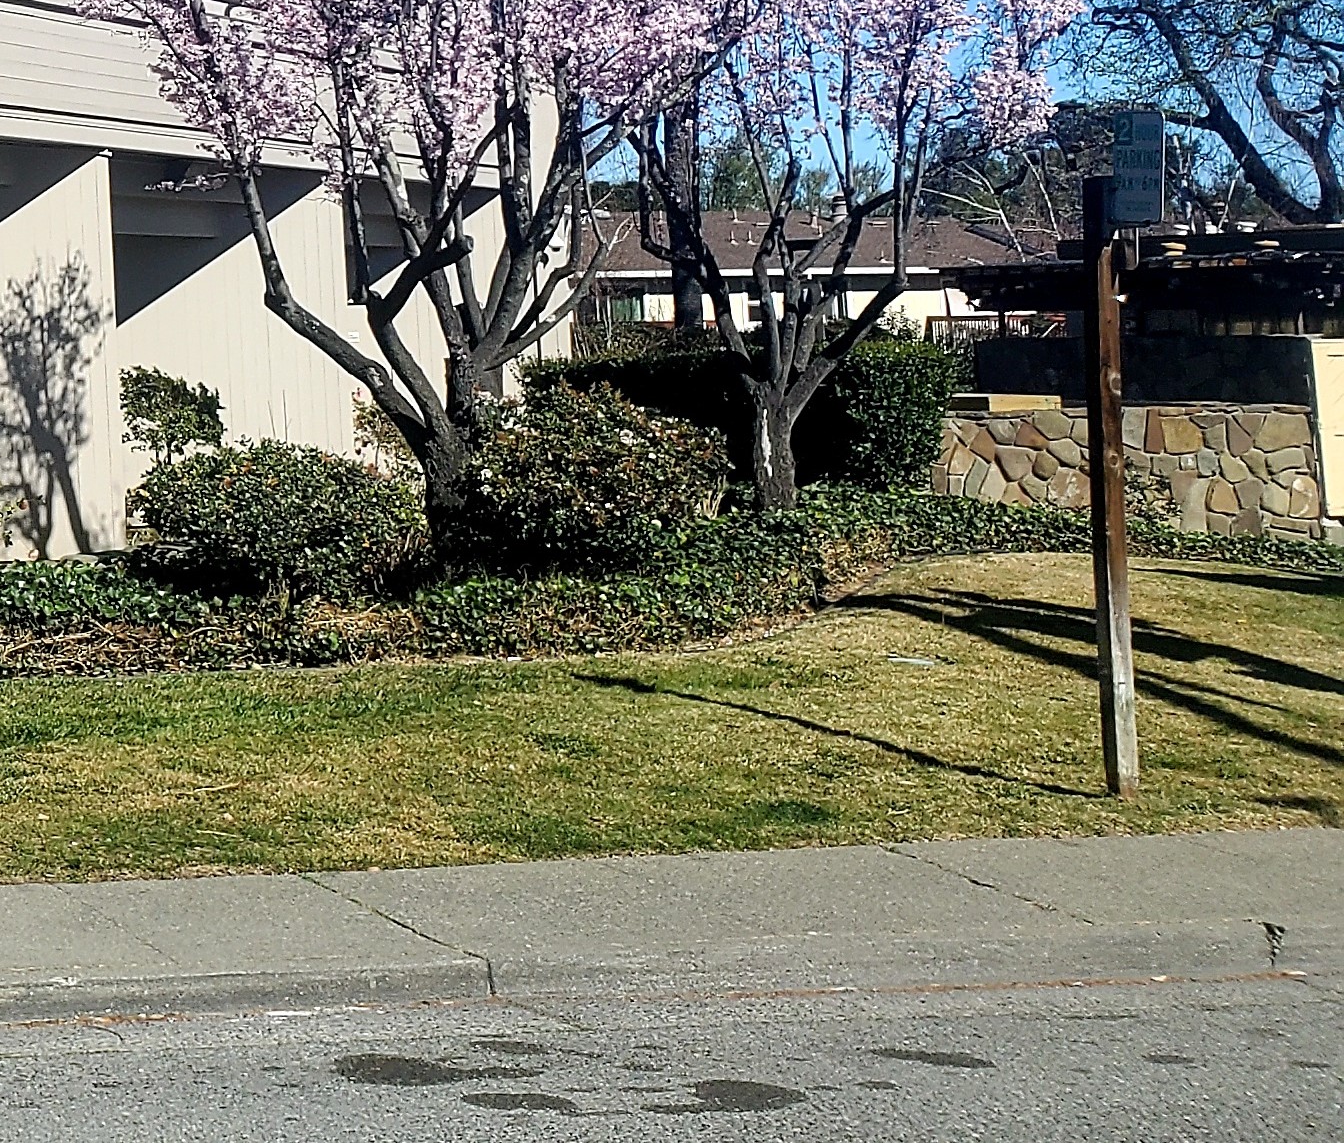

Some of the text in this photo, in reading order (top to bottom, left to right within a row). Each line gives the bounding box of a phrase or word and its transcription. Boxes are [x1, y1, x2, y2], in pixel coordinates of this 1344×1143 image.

[1119, 119, 1160, 141] 2 HOUR
[1116, 149, 1160, 170] PARKING
[1142, 175, 1160, 191] 6PM
